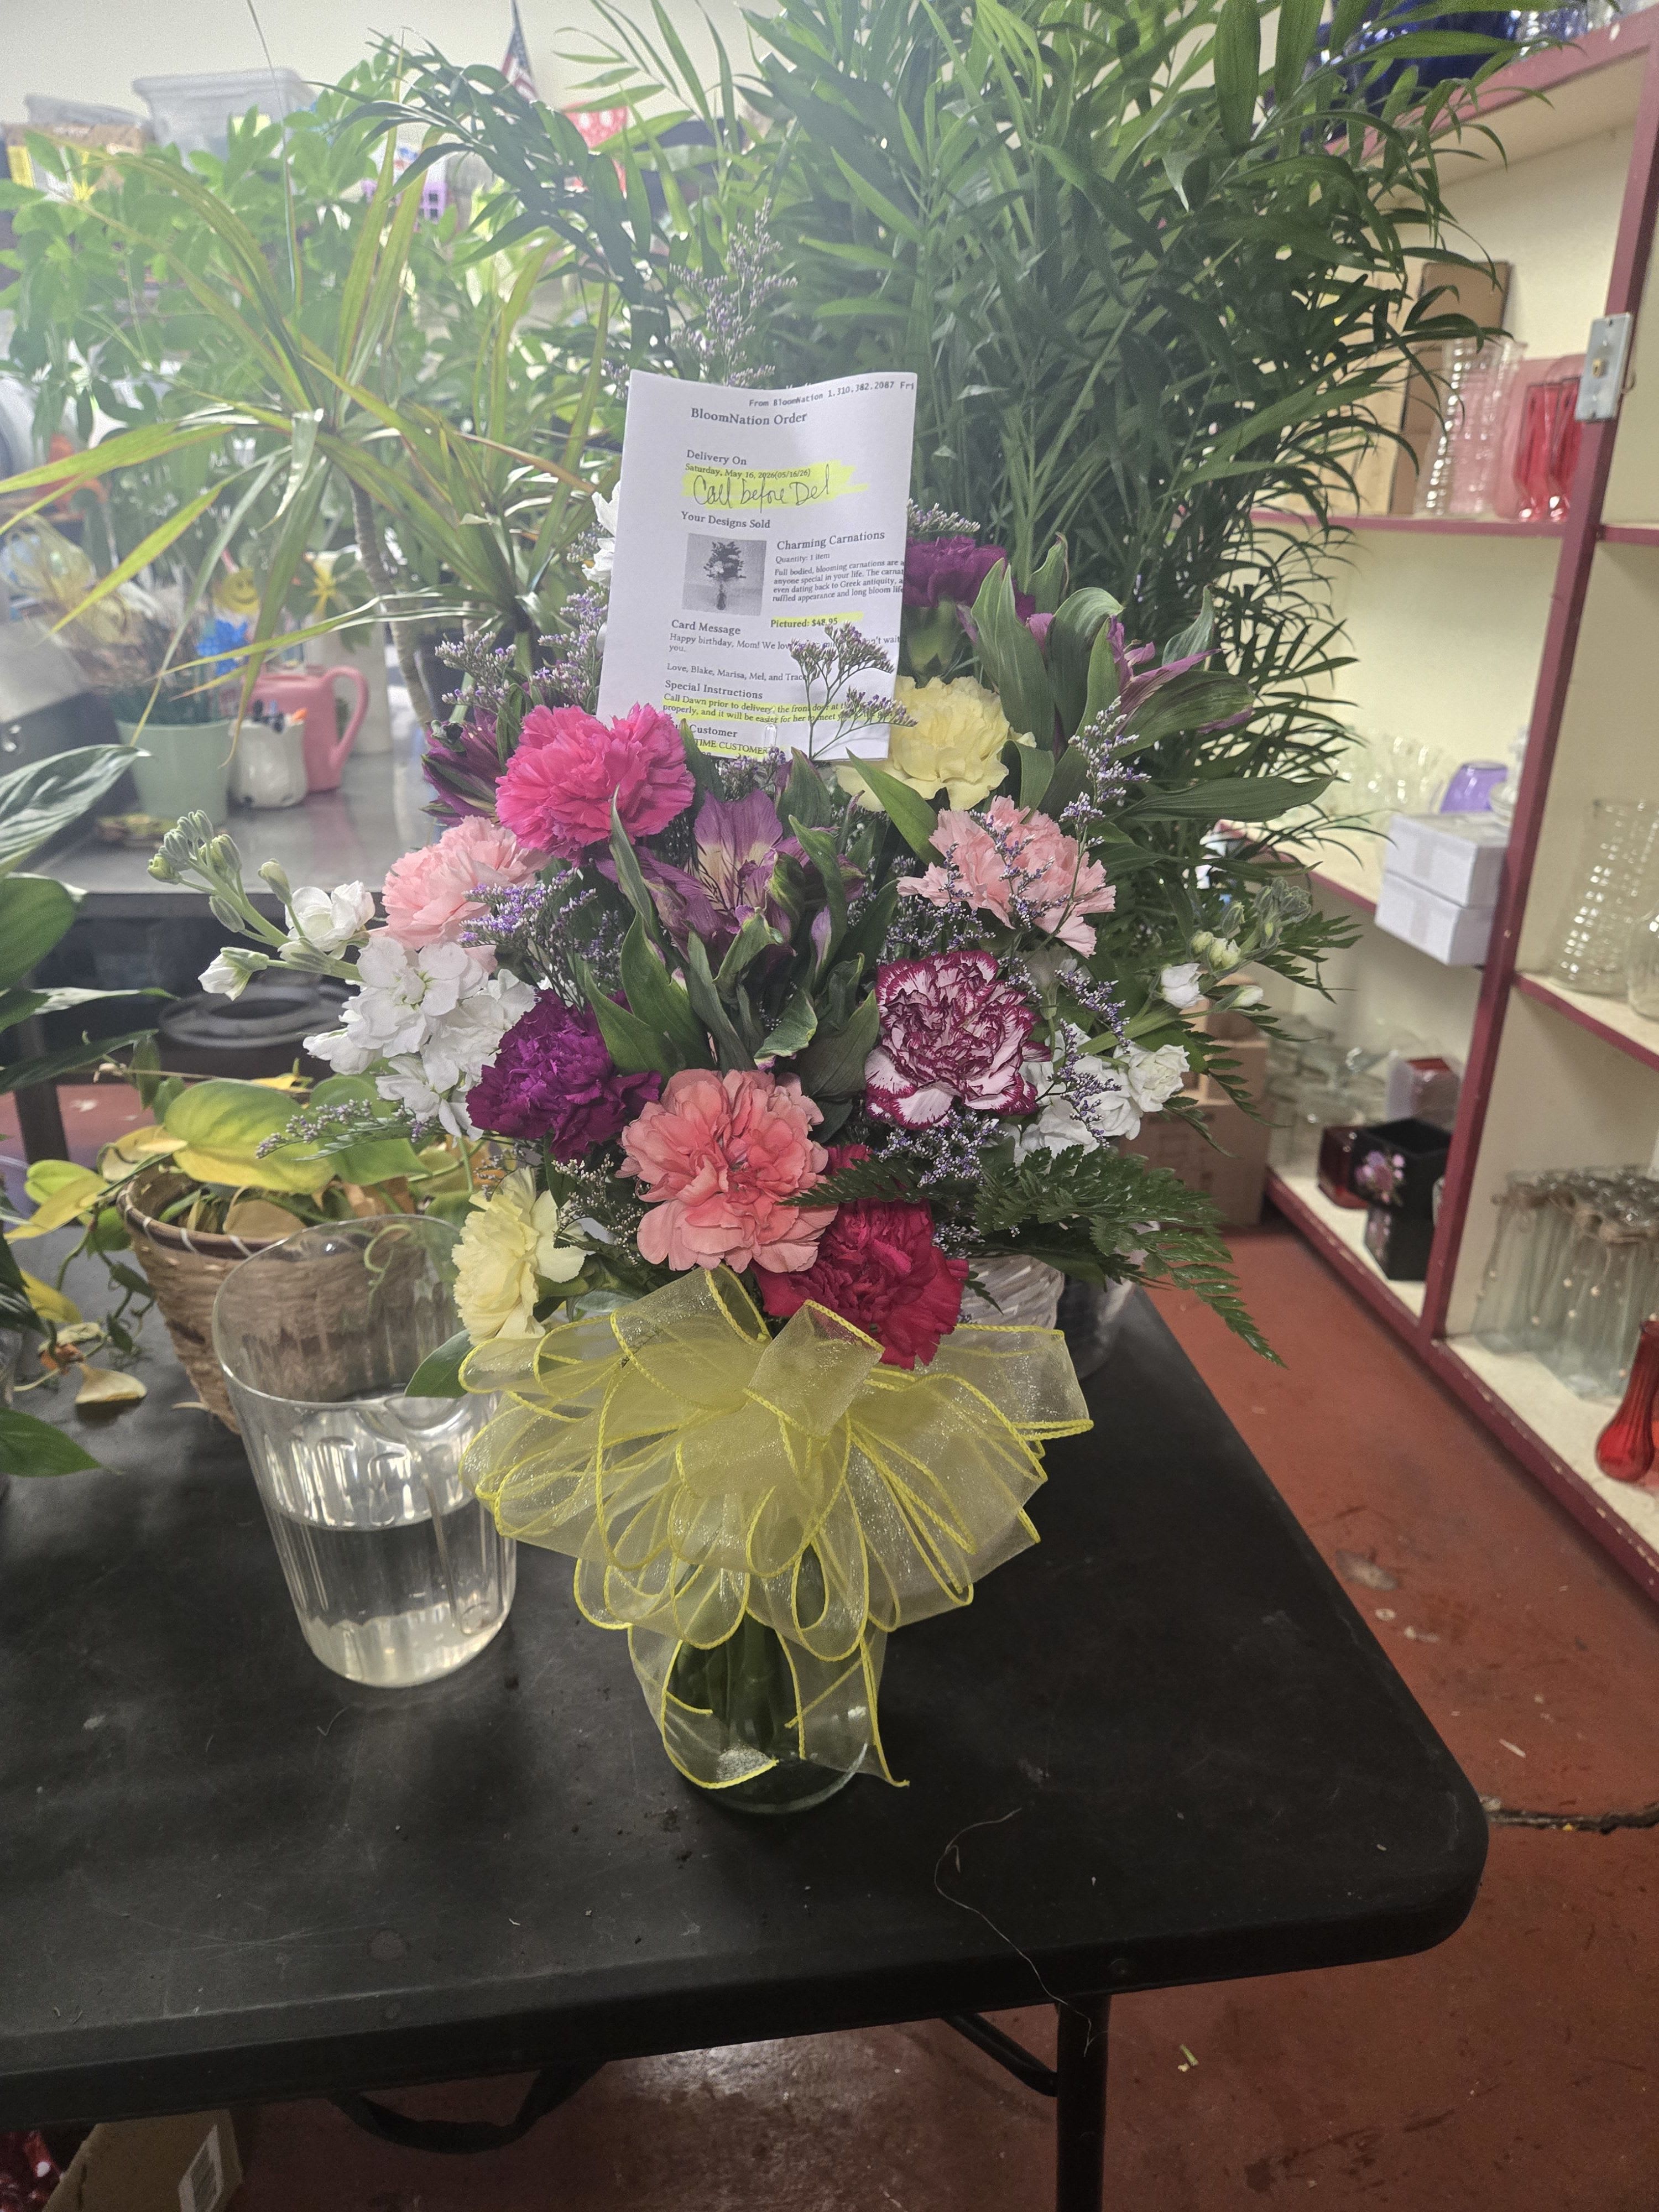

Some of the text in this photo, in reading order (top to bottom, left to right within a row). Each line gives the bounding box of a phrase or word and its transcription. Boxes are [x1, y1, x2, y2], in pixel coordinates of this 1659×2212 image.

[749, 399, 769, 407] From
[773, 393, 823, 406] BloomNation
[828, 381, 895, 398] 1.310.382.2087
[691, 407, 808, 425] BloomNation Order
[687, 449, 747, 465] Delivery On
[724, 468, 742, 479] May
[693, 463, 830, 514] Call before Del
[681, 511, 771, 529] Your Designs Sold
[776, 531, 885, 550] Charming Carnations
[775, 556, 808, 565] Quantity:
[790, 567, 815, 575] bodied,
[816, 564, 847, 573] blooming
[848, 560, 885, 569] carnations
[791, 585, 813, 593] dating
[814, 582, 830, 591] back
[839, 579, 862, 588] Greek
[862, 577, 897, 586] antiquity,
[800, 575, 823, 585] special
[833, 573, 849, 582] your
[797, 592, 836, 603] appearance
[837, 589, 850, 597] and
[852, 588, 868, 597] long
[868, 586, 891, 594] bloom
[671, 619, 742, 637] Card Message
[770, 619, 810, 628] Pictured:
[669, 644, 686, 653] you.
[670, 633, 697, 645] Happy
[698, 635, 734, 648] birthday,
[737, 640, 760, 649] Mom!
[883, 636, 900, 644] wait
[667, 663, 689, 673] Love,
[691, 665, 716, 676] Blake,
[717, 669, 747, 681] Marisa,
[749, 672, 767, 681] Mel,
[665, 680, 764, 700] Special Instructions
[664, 693, 680, 702] Call
[682, 696, 707, 705] Dawn
[777, 705, 790, 713] the
[664, 705, 699, 716] properly,
[701, 708, 717, 717] and
[744, 712, 754, 721] be
[690, 724, 738, 738] Customer
[695, 738, 768, 755] TIME CUSTOMER
